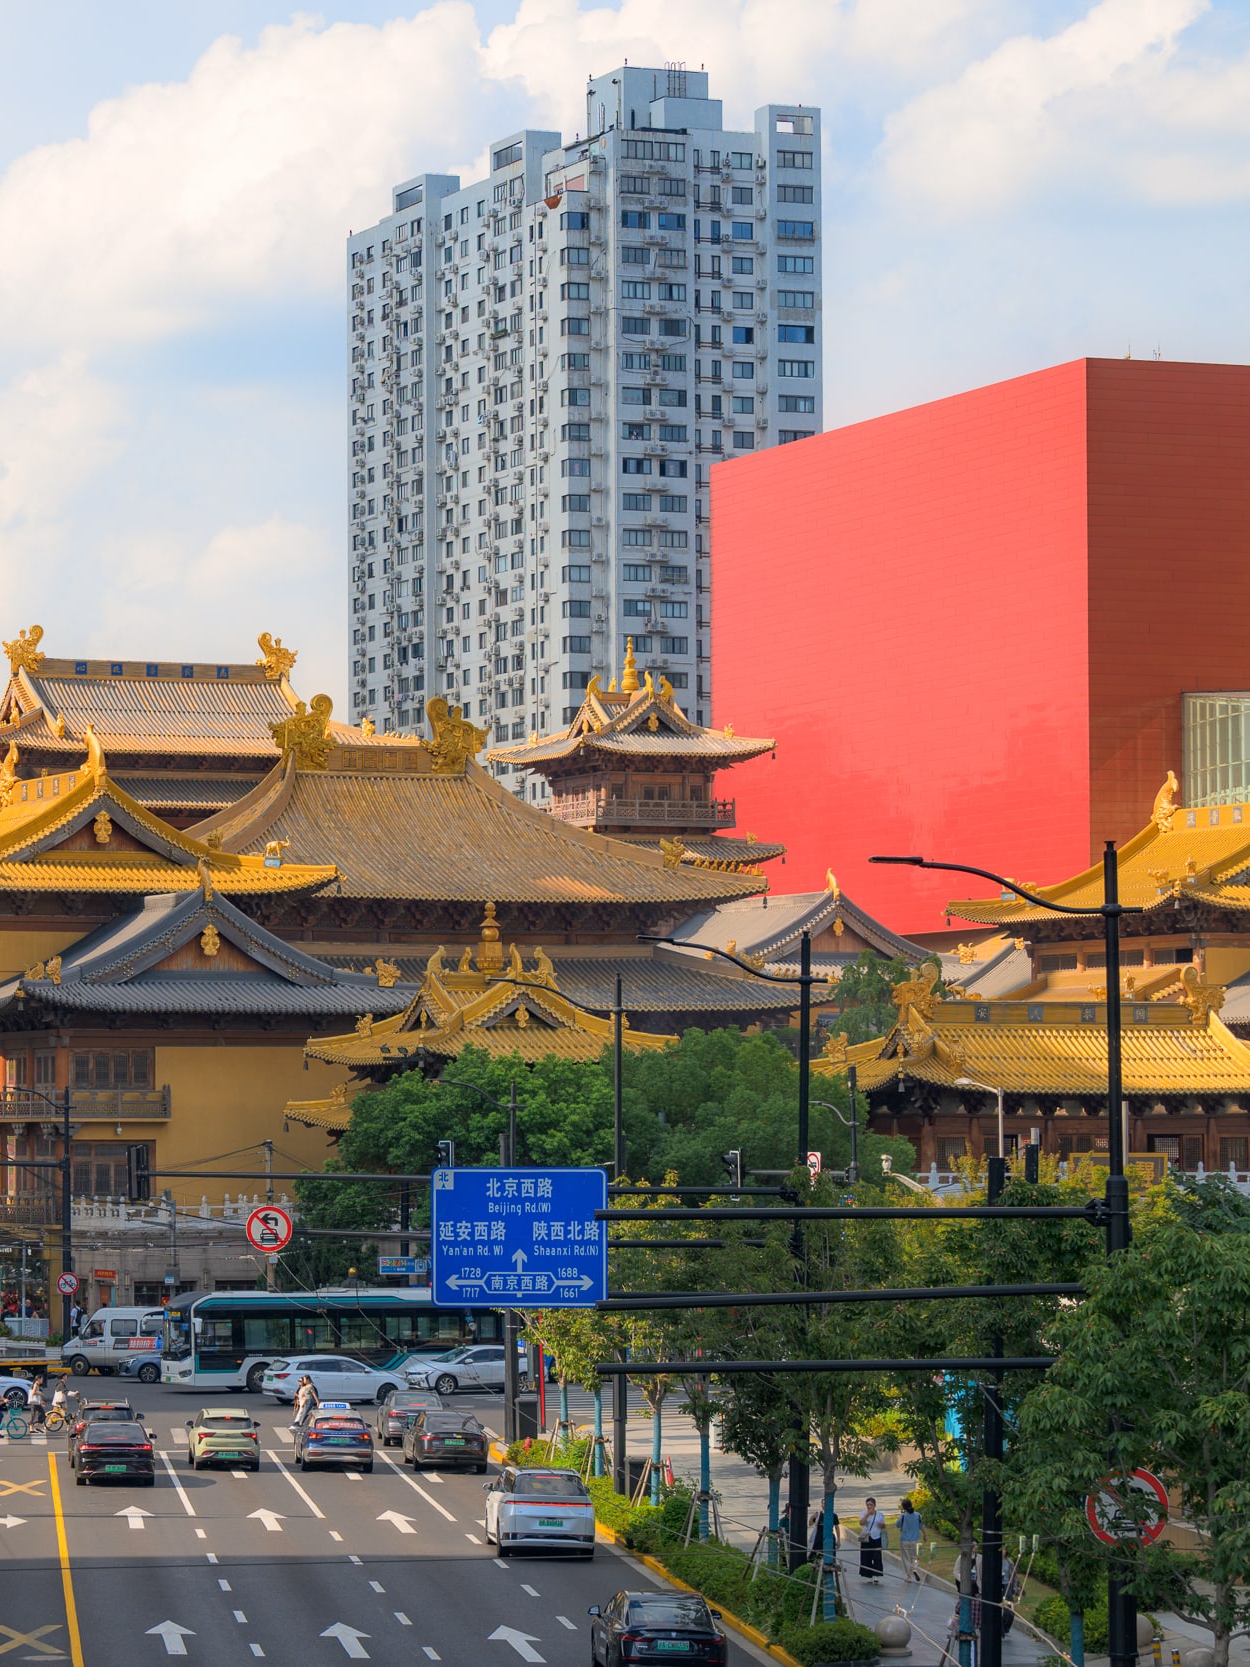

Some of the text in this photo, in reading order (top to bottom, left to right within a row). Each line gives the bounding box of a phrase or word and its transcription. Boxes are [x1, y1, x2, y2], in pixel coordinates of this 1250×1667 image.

[438, 1171, 449, 1183] 北
[486, 1177, 553, 1198] 北京西路
[488, 1202, 551, 1216] Beijing Rd.(W)
[439, 1221, 506, 1241] 延安西路
[533, 1221, 599, 1241] 陕西北路
[442, 1245, 474, 1256] Yan'an
[533, 1245, 599, 1256] Shaanxi Rd.(N)
[461, 1267, 481, 1278] 1728
[558, 1267, 578, 1278] 1688
[491, 1275, 549, 1291] 南京西路
[462, 1287, 480, 1298] 1717
[560, 1287, 578, 1298] 1661
